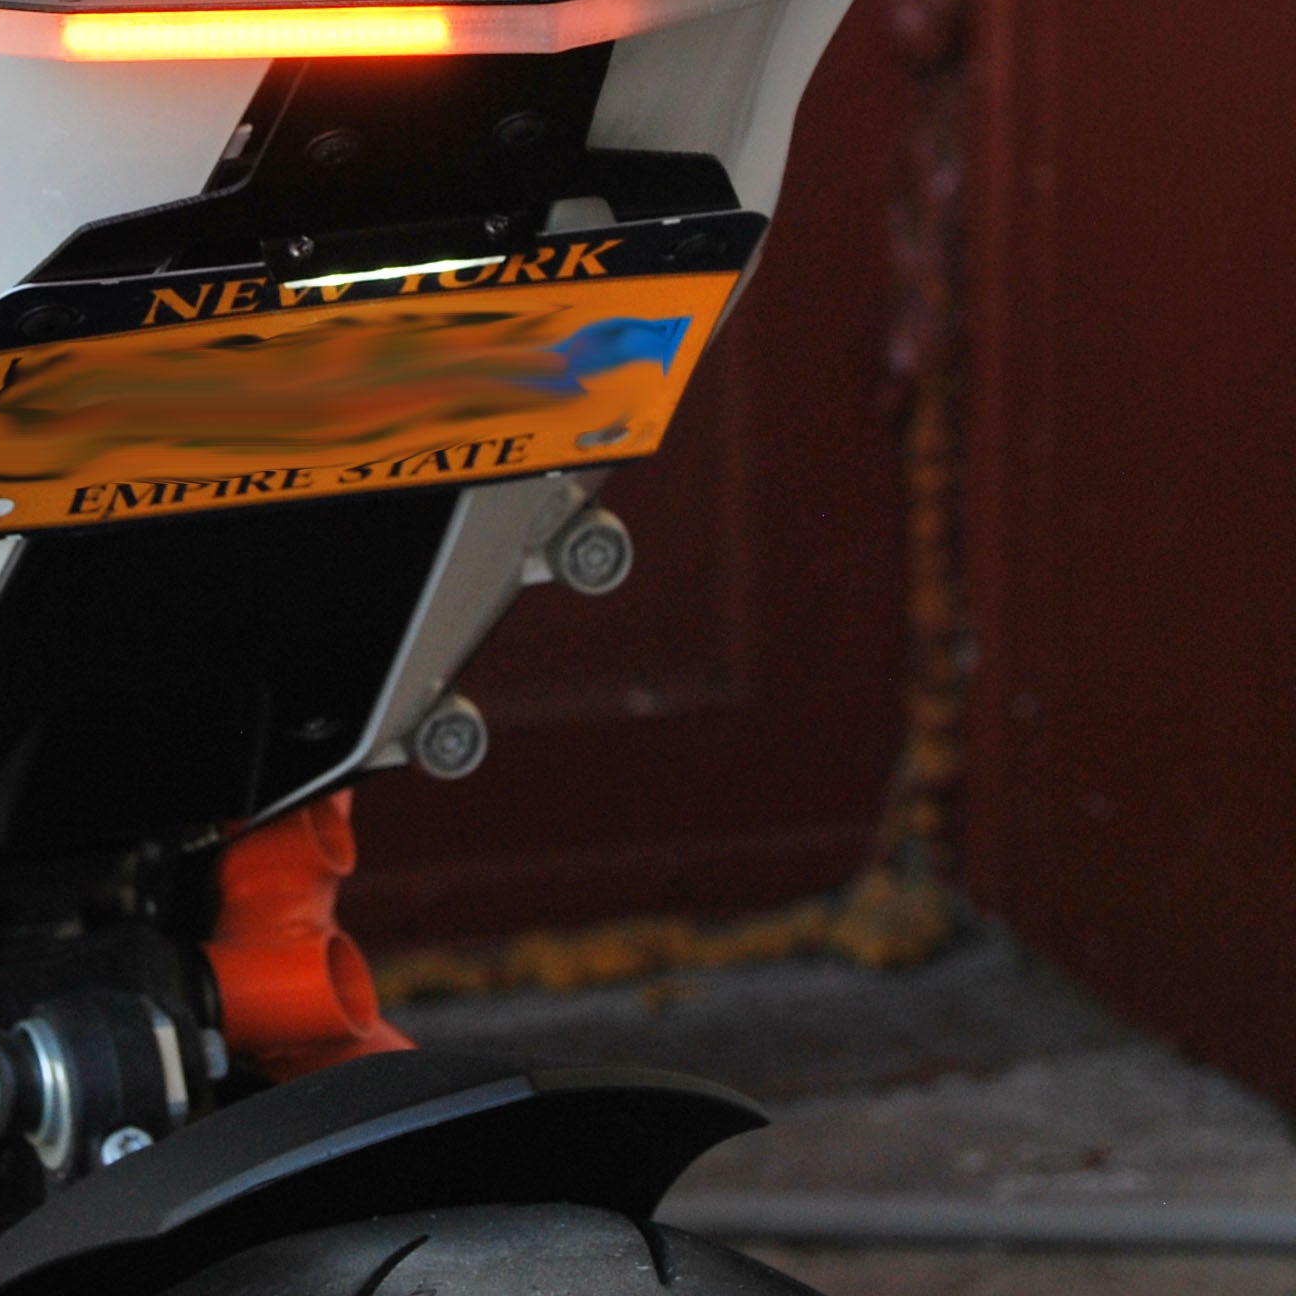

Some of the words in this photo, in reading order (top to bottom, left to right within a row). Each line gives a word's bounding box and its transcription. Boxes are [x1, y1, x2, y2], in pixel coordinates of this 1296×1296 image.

[142, 277, 354, 326] NEW
[399, 239, 625, 294] YORK
[67, 466, 313, 517] EMPIRE
[338, 432, 536, 484] STATE
